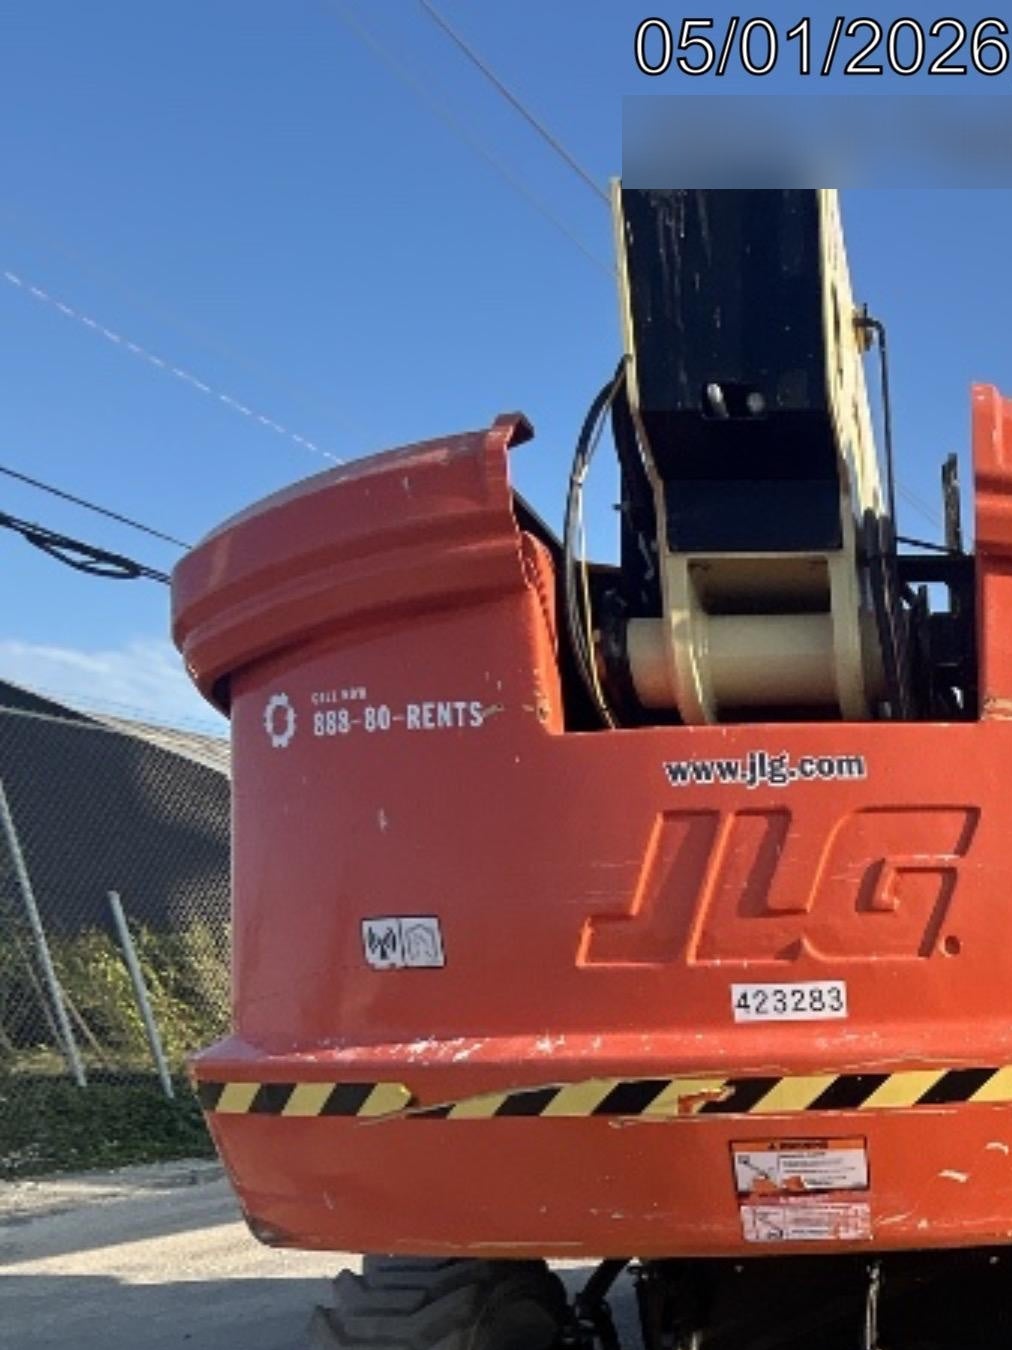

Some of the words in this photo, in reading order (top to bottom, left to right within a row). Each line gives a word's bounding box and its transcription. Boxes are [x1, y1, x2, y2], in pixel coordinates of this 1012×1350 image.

[313, 701, 484, 736] 888-80-RENTS
[664, 751, 866, 788] www.jlg.com
[576, 805, 981, 968] JLG
[734, 986, 845, 1015] 423283
